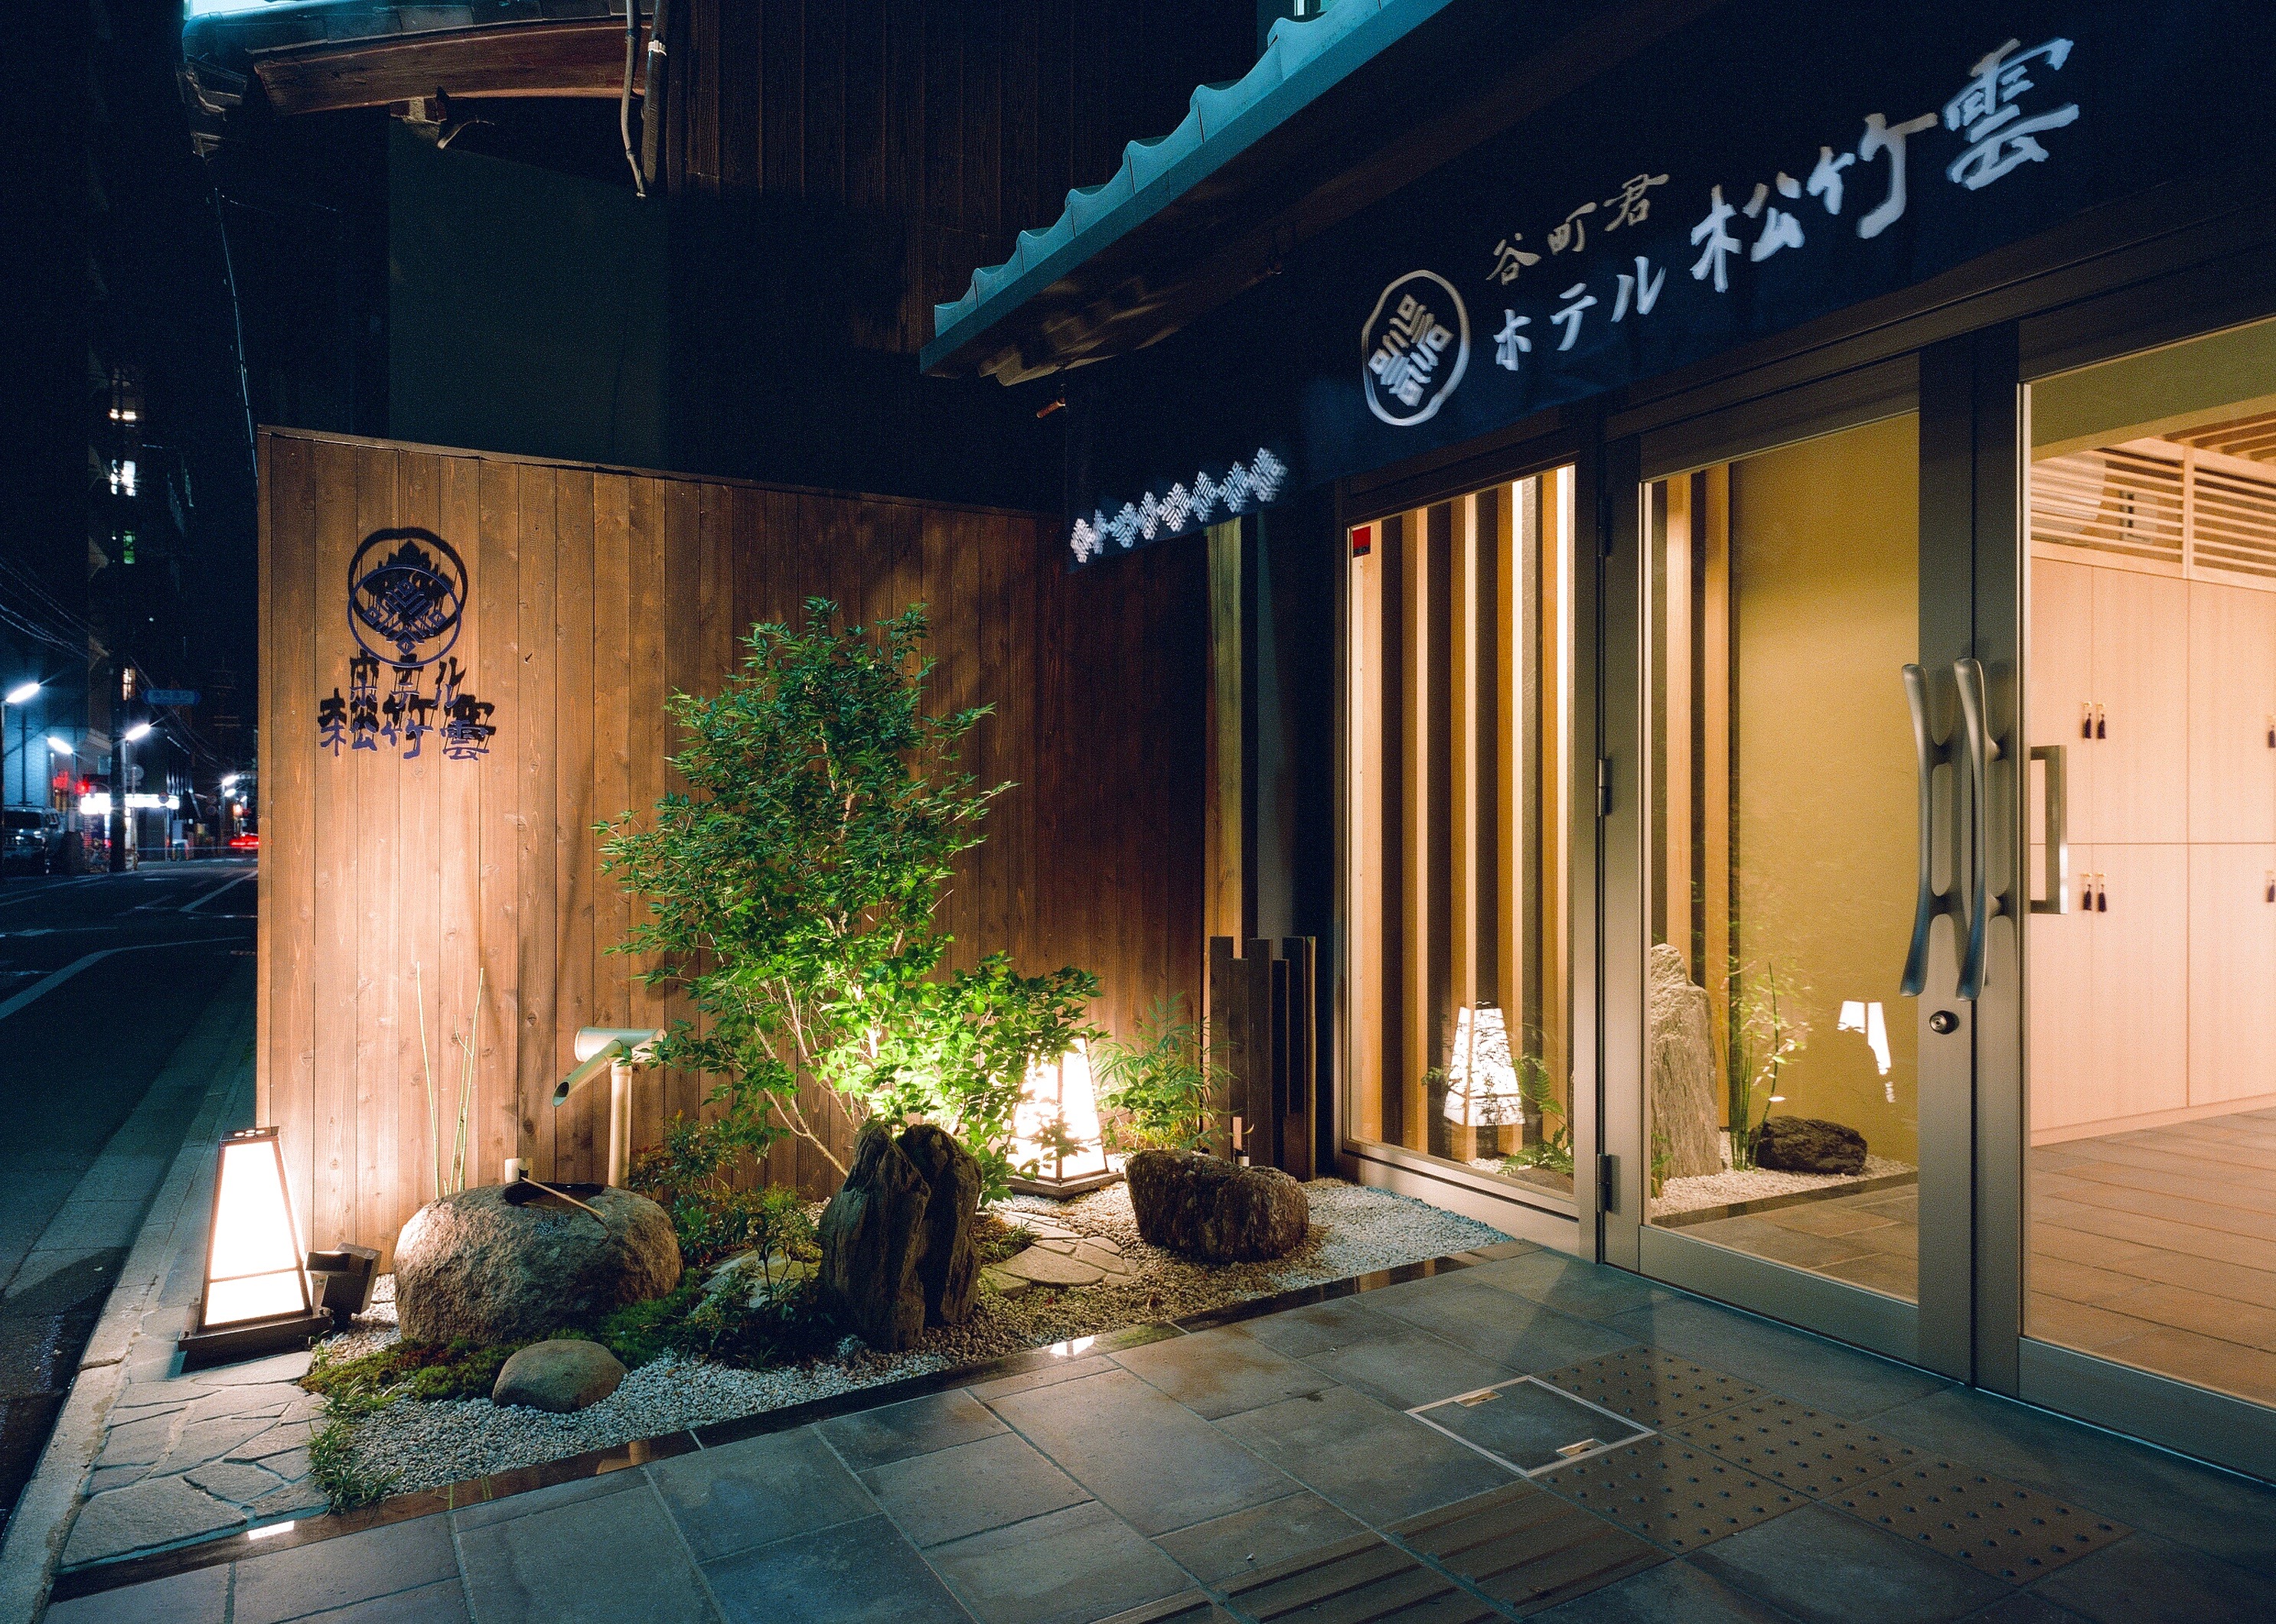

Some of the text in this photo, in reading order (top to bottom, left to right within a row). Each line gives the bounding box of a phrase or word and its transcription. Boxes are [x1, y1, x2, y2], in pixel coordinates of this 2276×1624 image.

[1486, 174, 1669, 285] 谷町君
[350, 677, 461, 709] ホテル
[320, 717, 490, 761] 松竹雲
